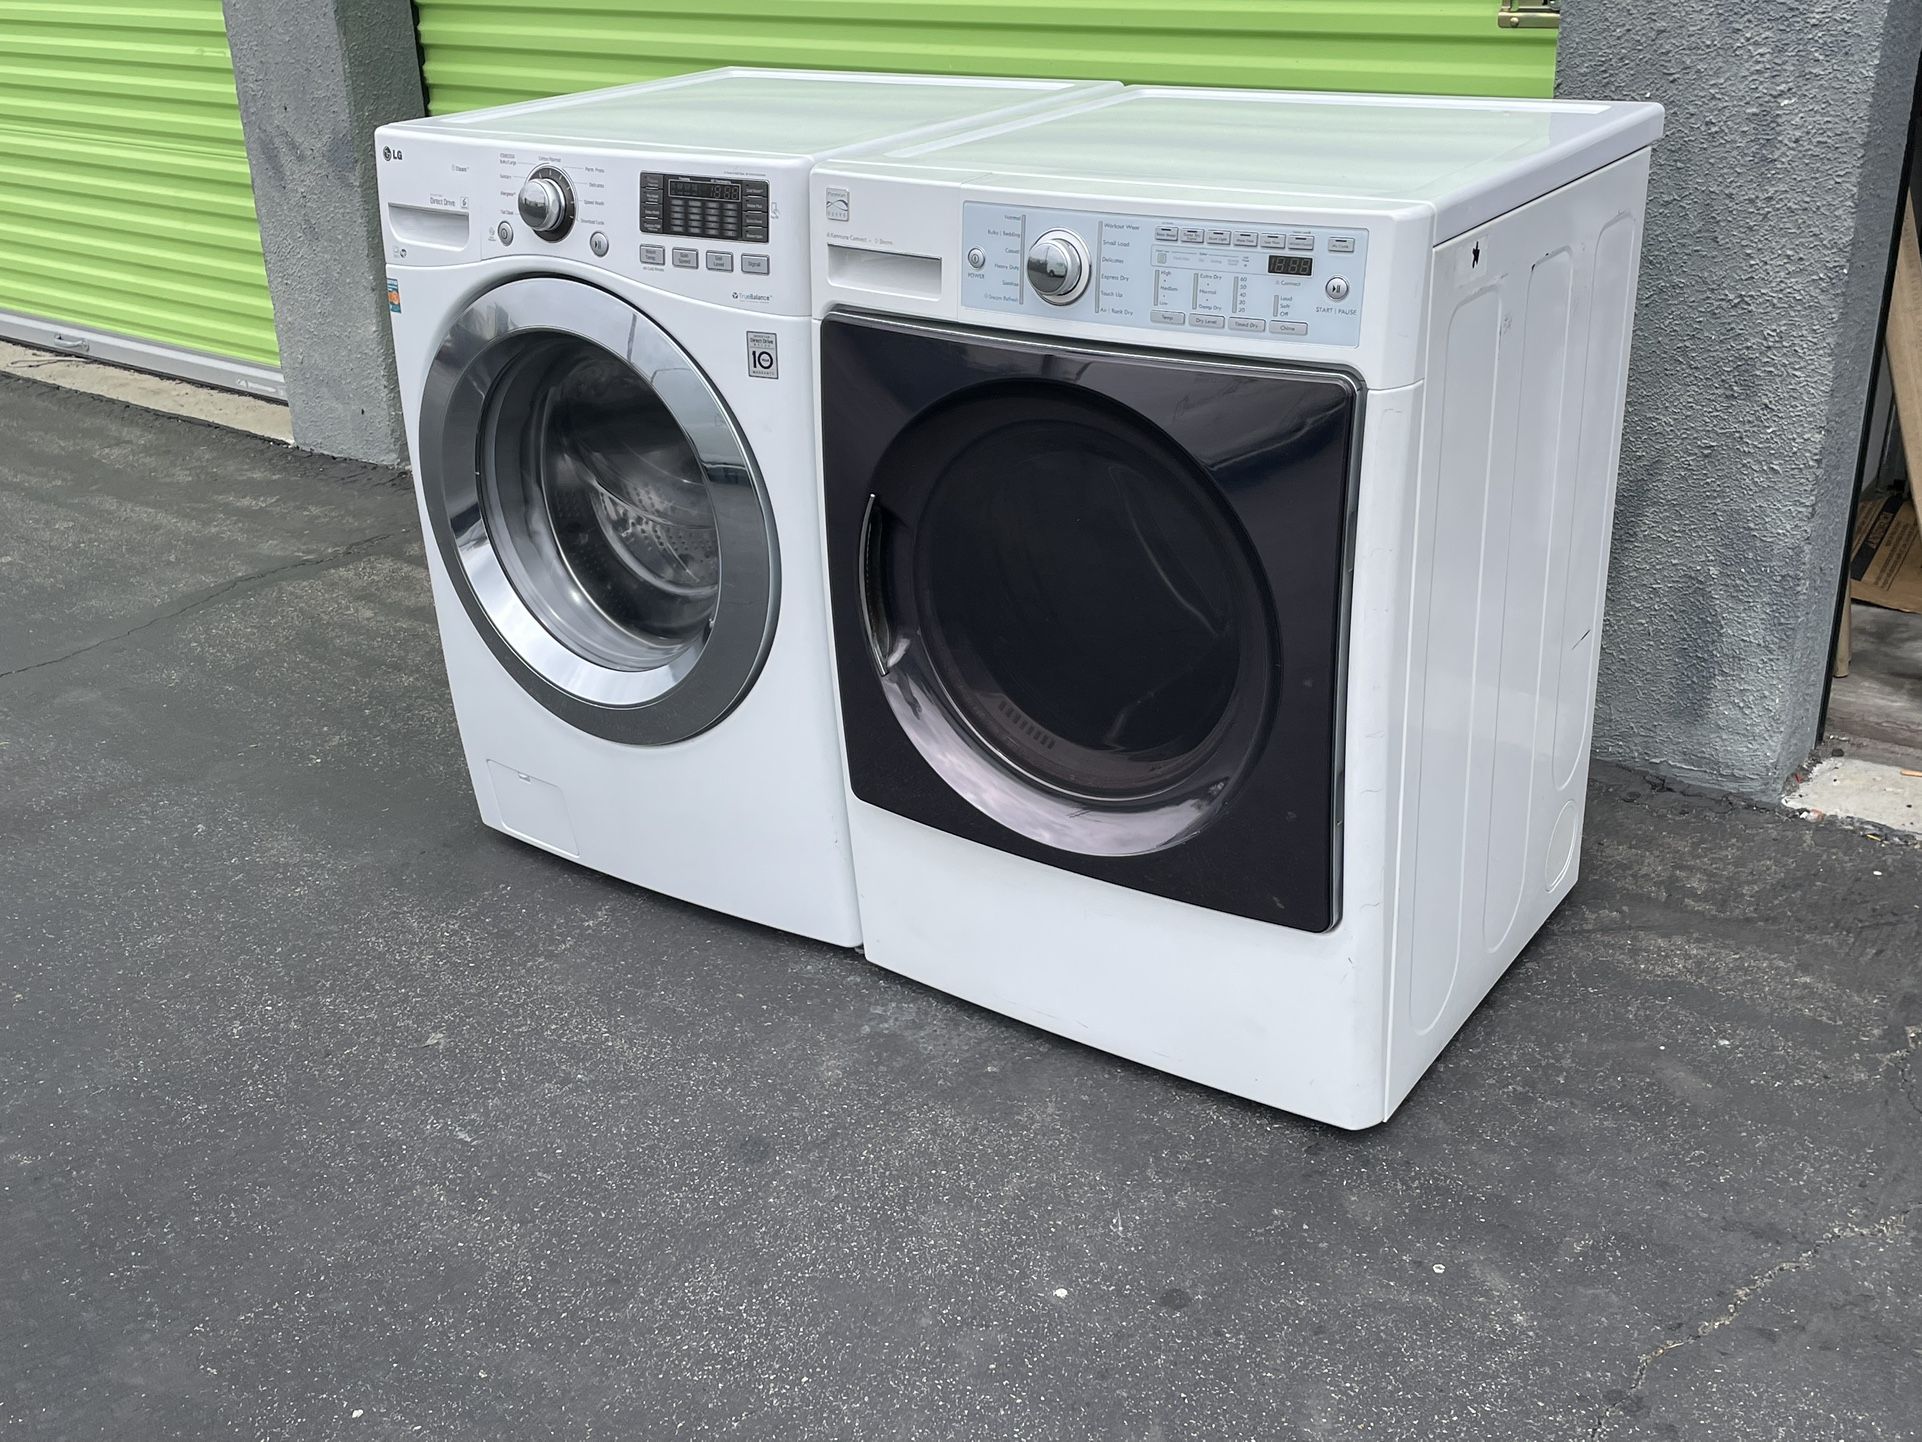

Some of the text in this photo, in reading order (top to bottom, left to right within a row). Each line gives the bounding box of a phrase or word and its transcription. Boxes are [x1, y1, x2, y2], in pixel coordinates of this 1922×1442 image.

[392, 149, 403, 160] LG
[430, 196, 443, 206] Direct
[444, 198, 456, 207] Drive
[968, 272, 984, 280] POWER
[1101, 274, 1119, 282] Express
[752, 350, 774, 370] 10
